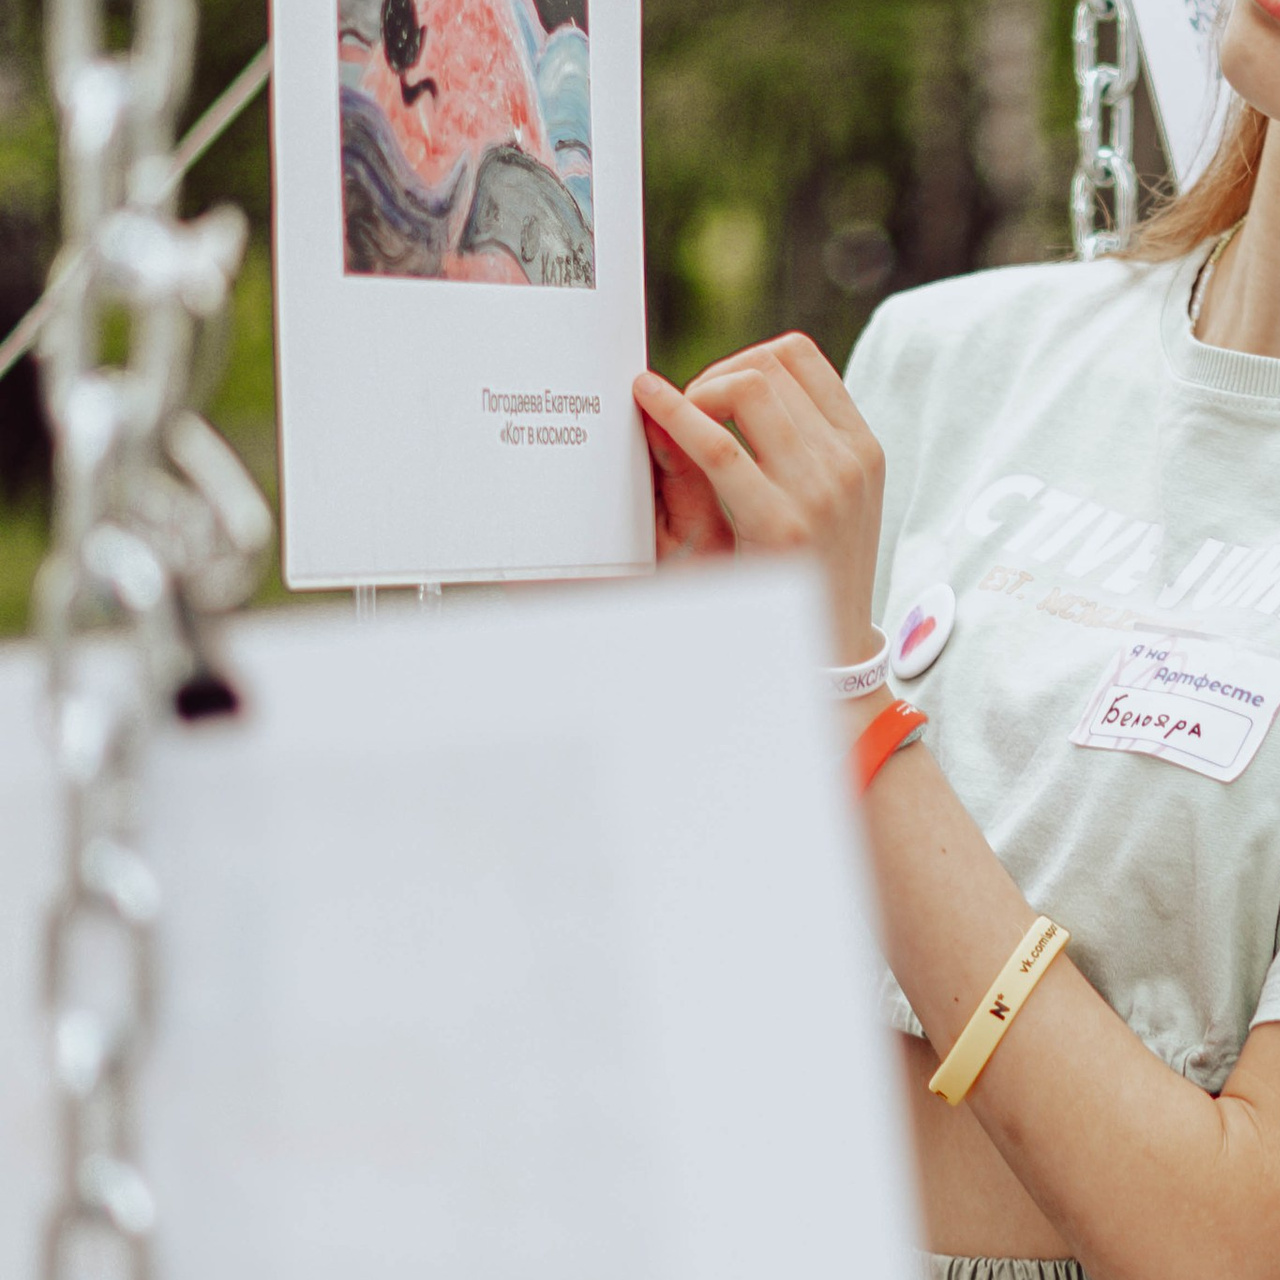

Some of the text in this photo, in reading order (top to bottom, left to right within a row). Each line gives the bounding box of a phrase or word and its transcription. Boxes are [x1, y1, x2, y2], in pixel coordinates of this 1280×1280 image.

[482, 387, 601, 420] Погодаева Екатерина
[500, 421, 588, 445] «Кот в космосе»
[963, 474, 1164, 595] CTIVE
[1145, 648, 1170, 662] на
[1153, 666, 1265, 708] Артфесте
